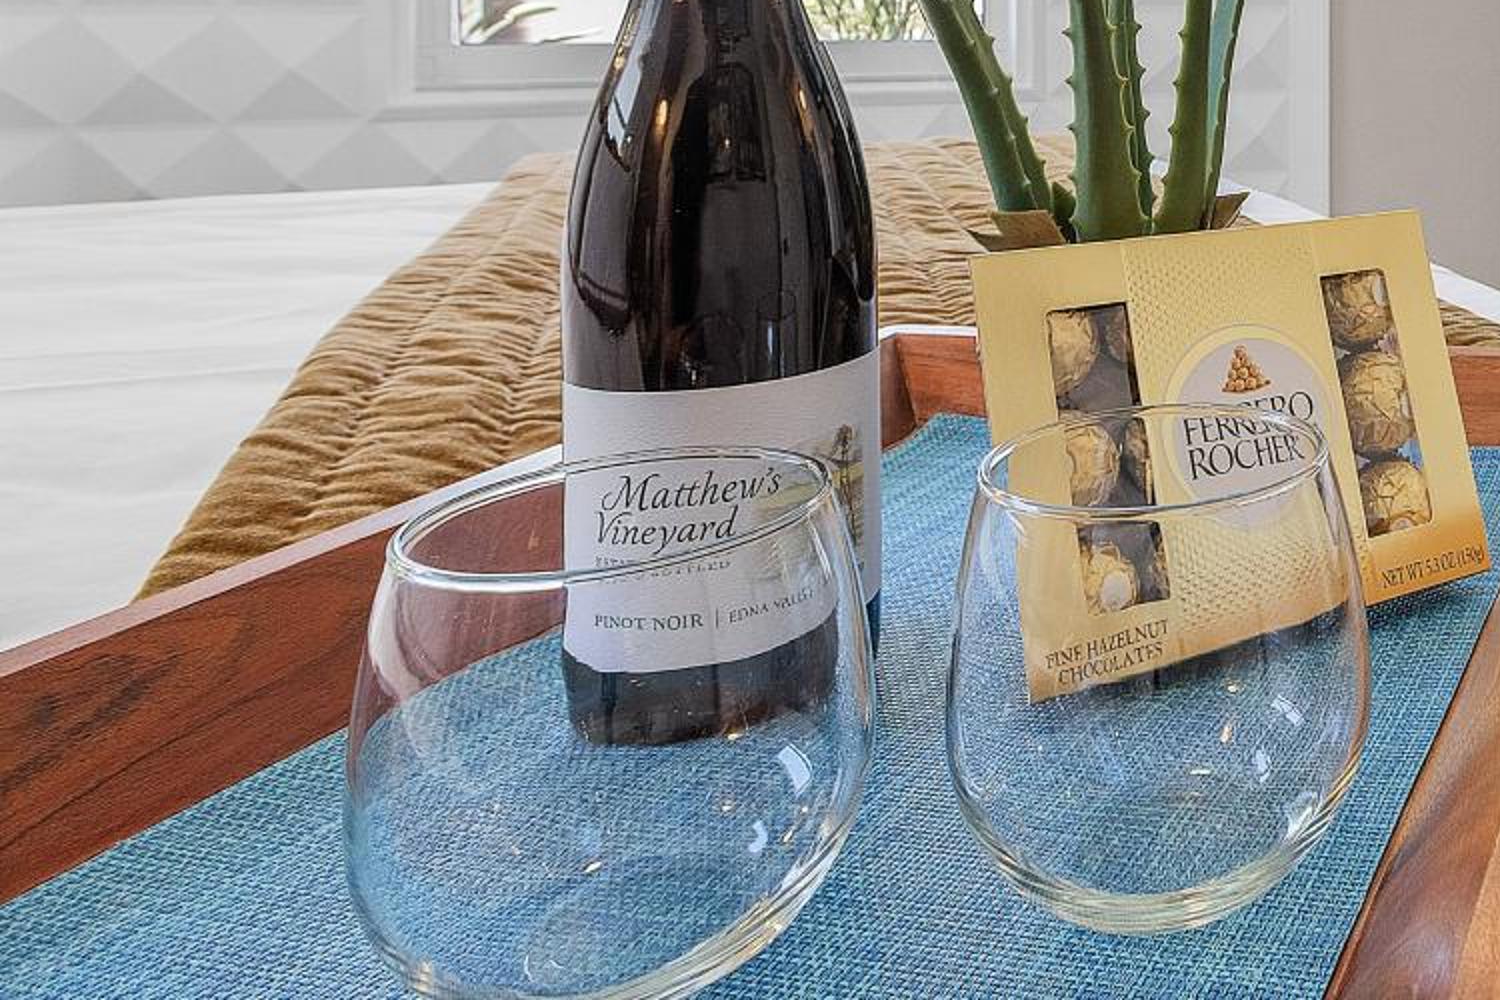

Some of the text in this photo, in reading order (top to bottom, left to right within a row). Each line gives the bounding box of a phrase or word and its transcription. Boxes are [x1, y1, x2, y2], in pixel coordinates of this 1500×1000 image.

[1187, 433, 1306, 480] ROCHER
[601, 467, 782, 511] Matthew's
[595, 504, 739, 555] Vineyard
[1381, 566, 1405, 589] NET
[1406, 560, 1424, 581] WT
[594, 614, 646, 631] PINOT
[651, 612, 704, 631] NOIR
[728, 602, 770, 623] EDNA
[1045, 619, 1168, 669] FINE HAZELNUT
[1058, 640, 1165, 686] CHOCOLATES
